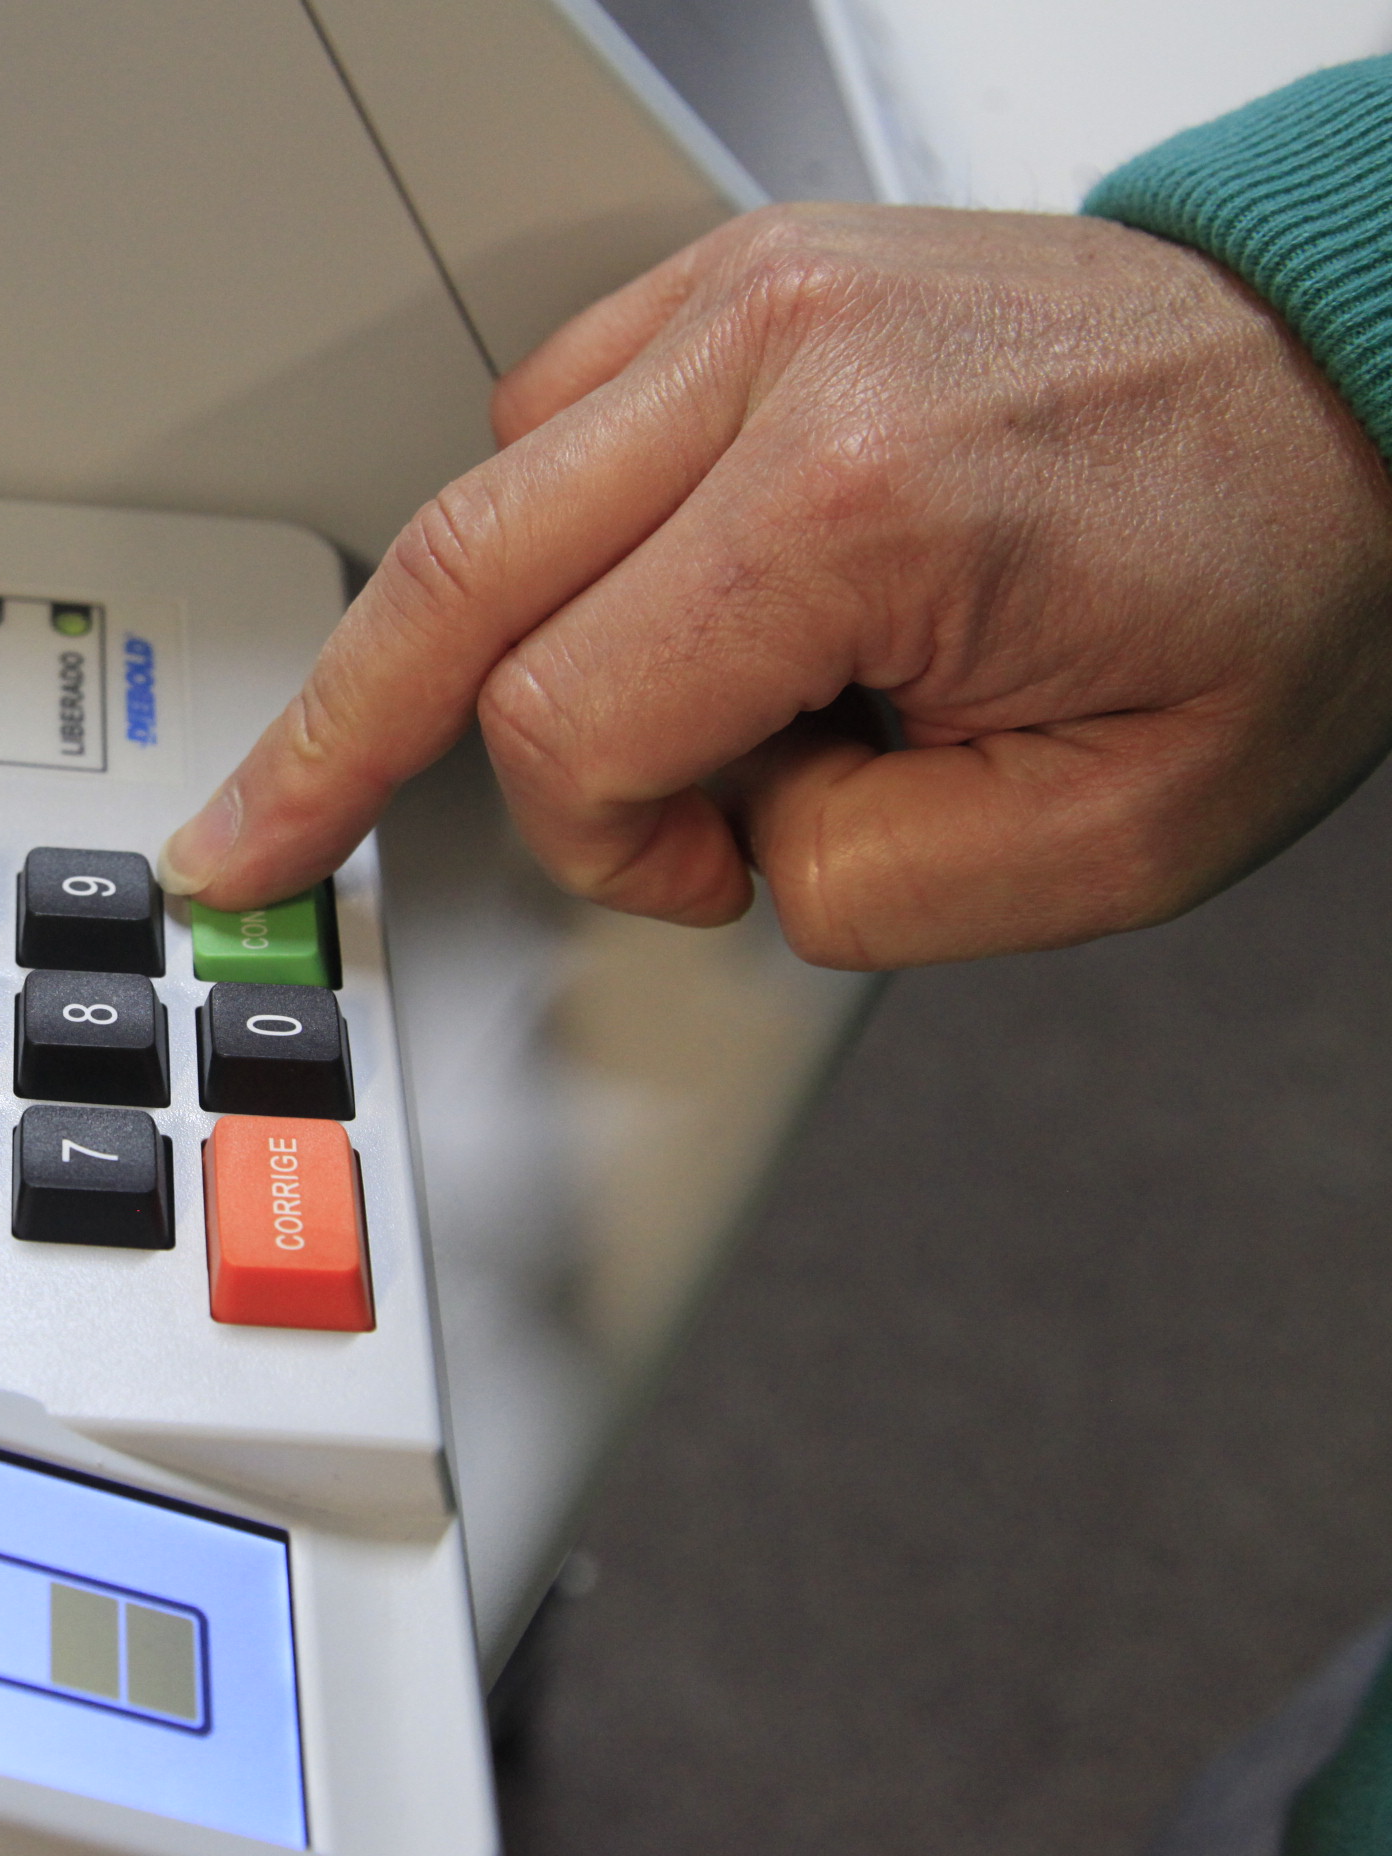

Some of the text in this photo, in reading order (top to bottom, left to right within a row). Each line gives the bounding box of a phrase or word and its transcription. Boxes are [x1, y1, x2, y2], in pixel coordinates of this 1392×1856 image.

[60, 650, 86, 756] LIBERADO
[61, 875, 117, 897] 9
[62, 1003, 119, 1025] 8
[246, 1014, 303, 1037] 0
[61, 1138, 119, 1163] 7
[269, 1137, 305, 1251] CORRIGE
